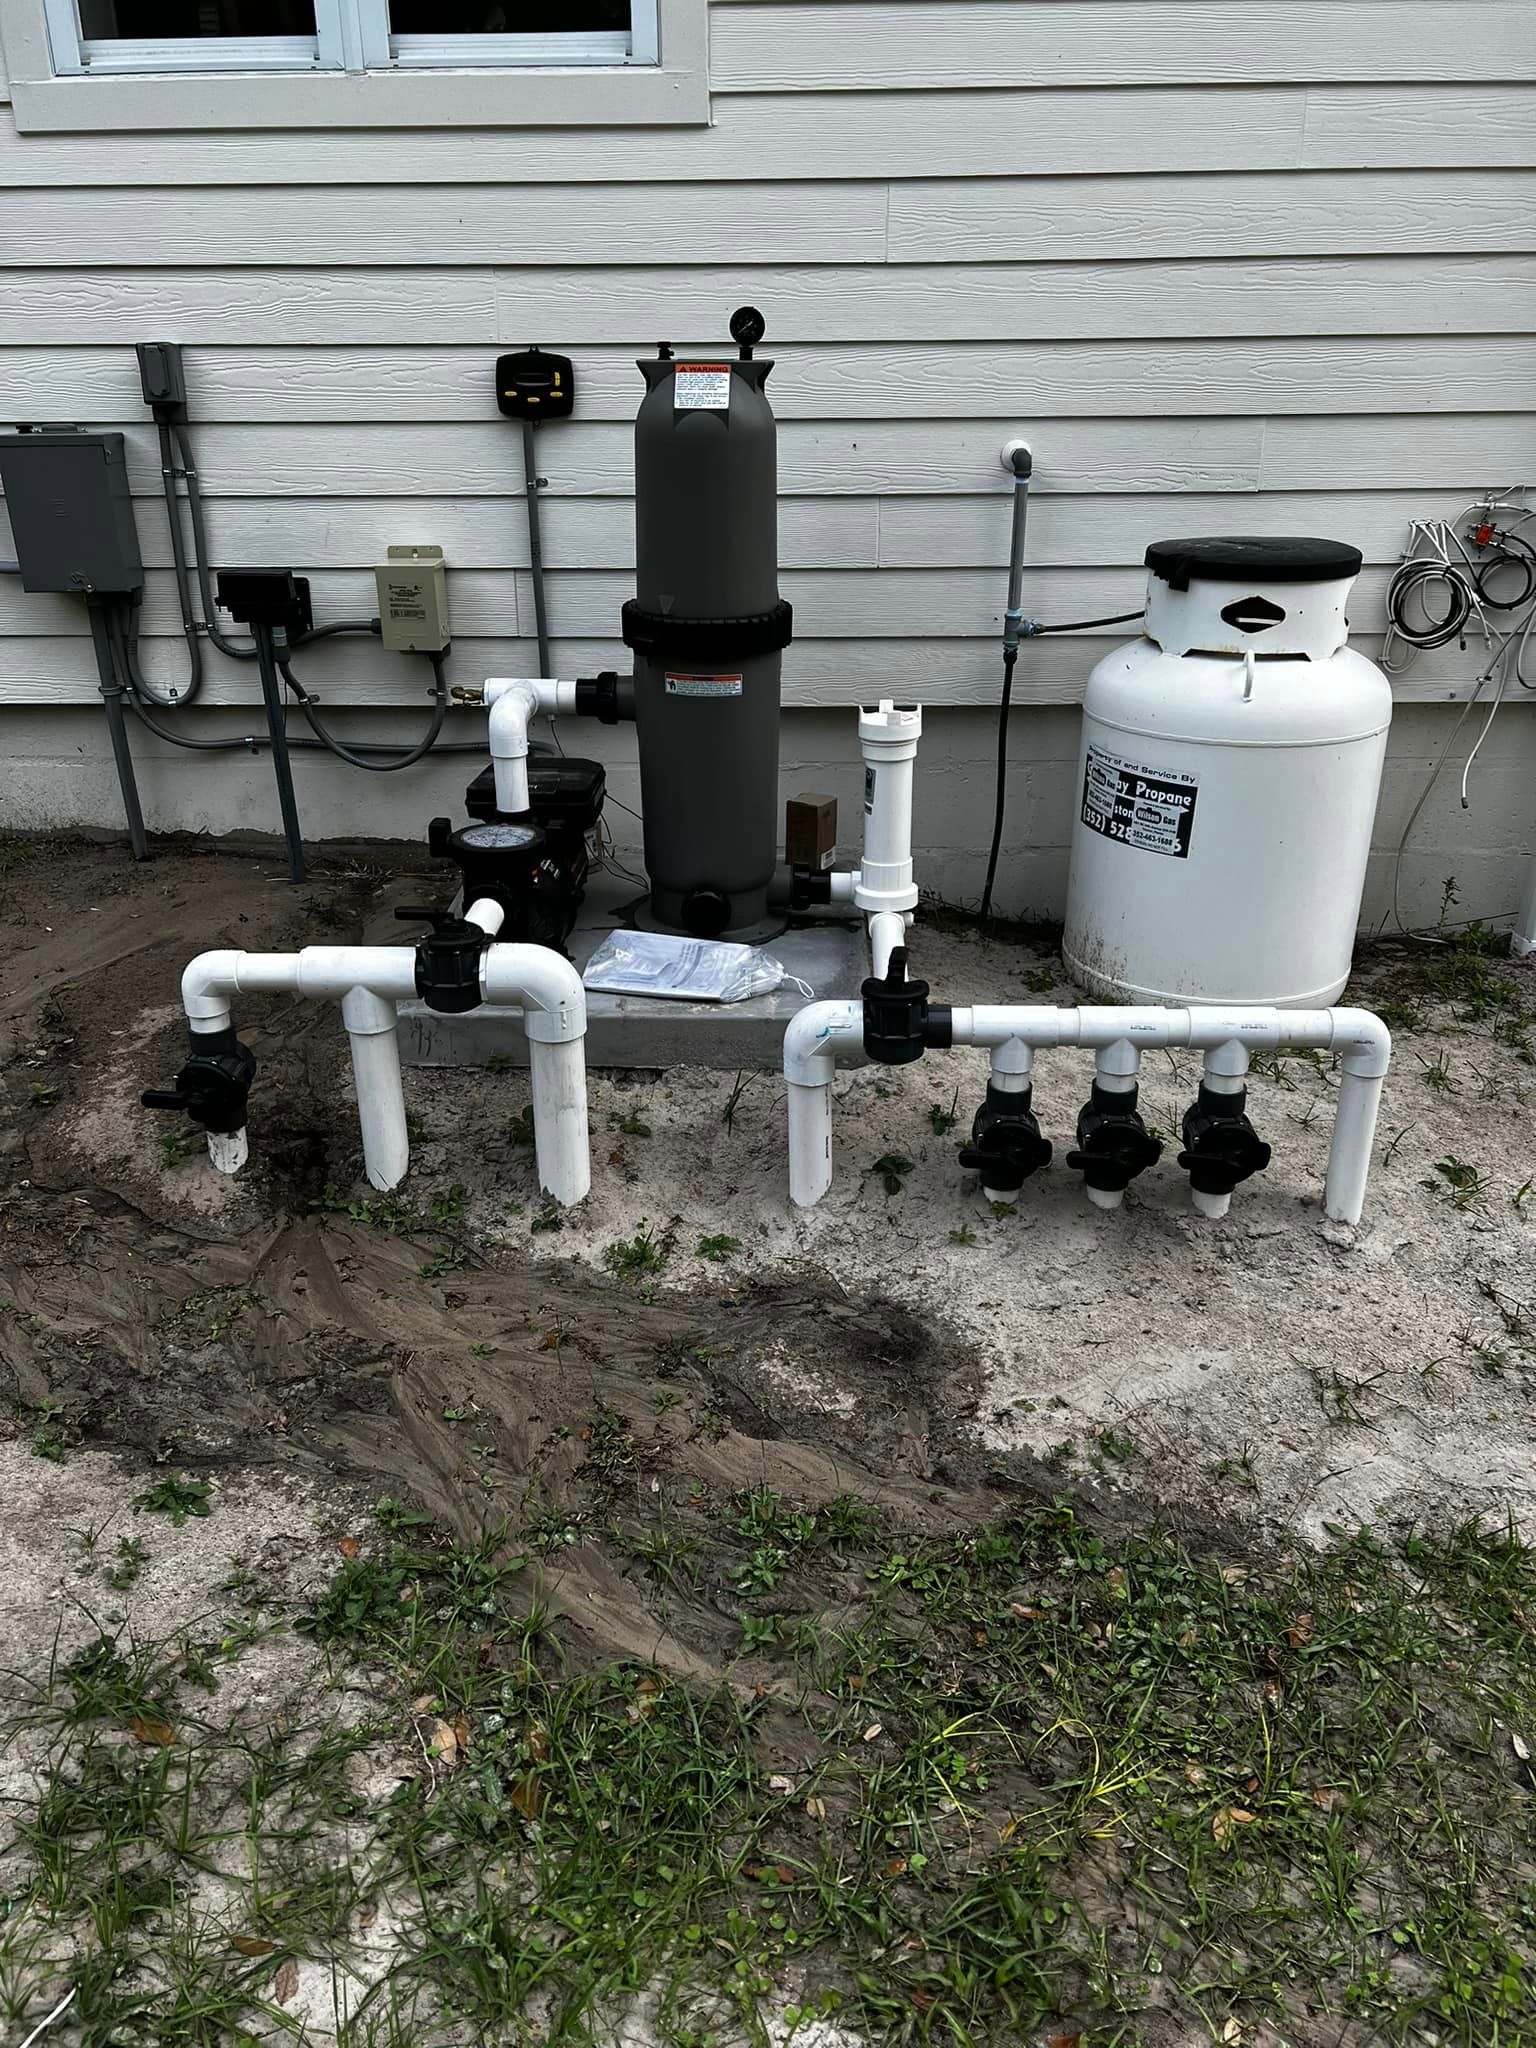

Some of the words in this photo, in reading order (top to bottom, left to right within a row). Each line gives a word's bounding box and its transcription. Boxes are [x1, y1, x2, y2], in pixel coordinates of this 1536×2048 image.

[1124, 763, 1138, 771] and
[1141, 767, 1178, 780] Service
[1181, 775, 1195, 784] By
[1135, 781, 1192, 806] Propane
[1083, 804, 1106, 832] (352)
